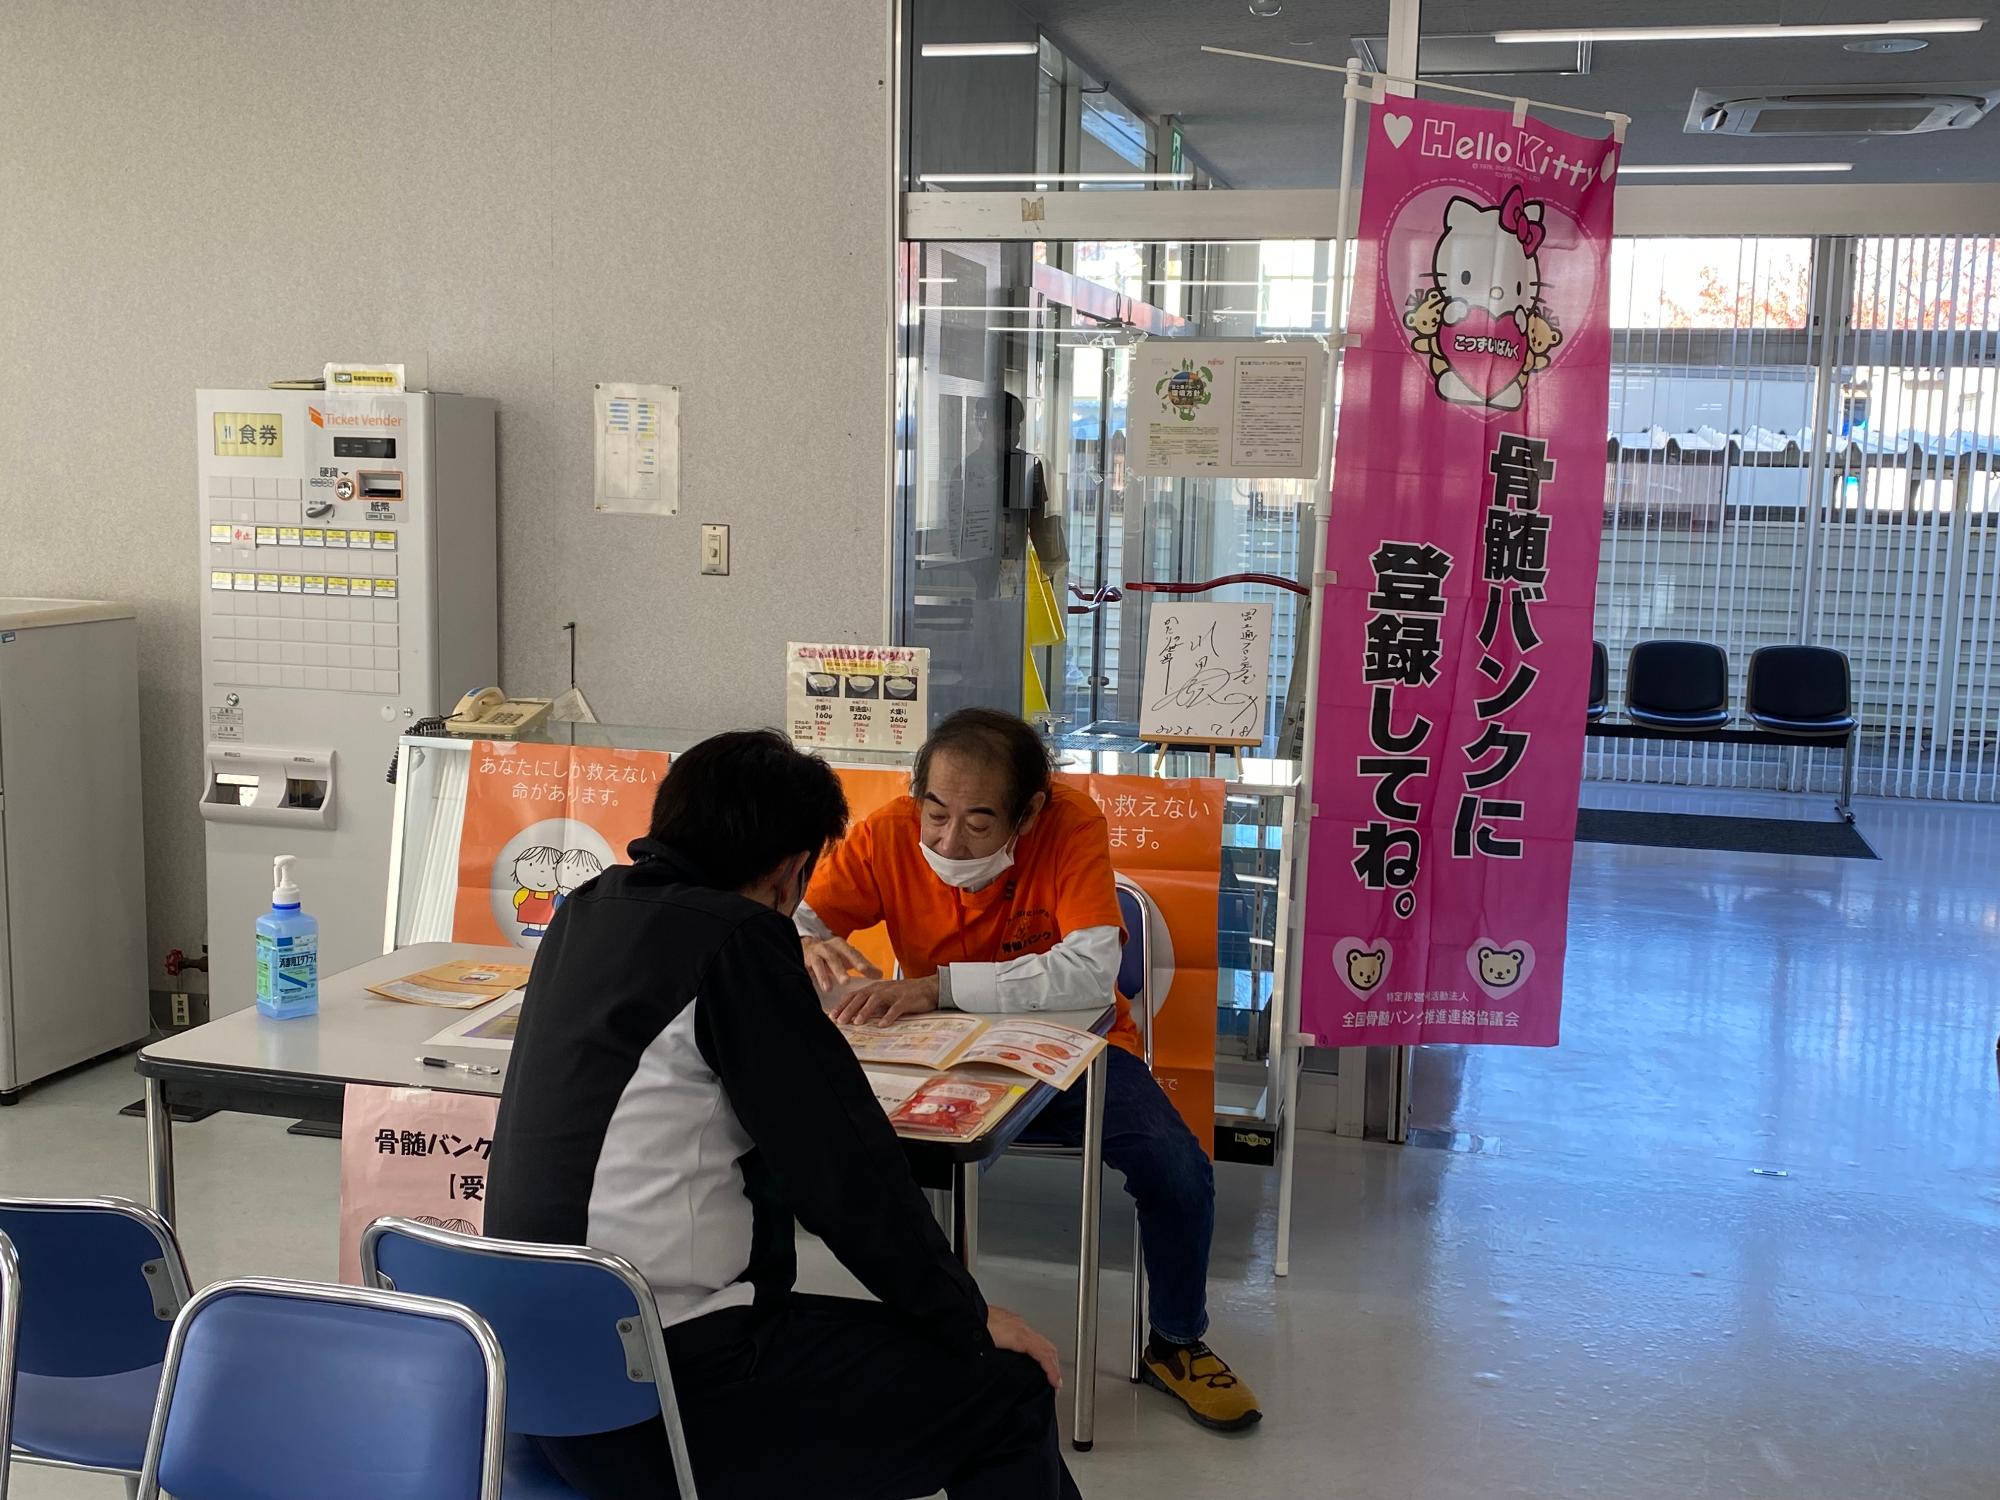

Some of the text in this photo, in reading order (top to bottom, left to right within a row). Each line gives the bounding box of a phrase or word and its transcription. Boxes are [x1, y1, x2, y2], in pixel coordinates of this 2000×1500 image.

[1421, 119, 1599, 192] Hello Kitty
[326, 413, 402, 427] Ticket Vender
[239, 424, 278, 446] 食券
[1452, 431, 1557, 860] 骨髄バンクに
[1351, 540, 1454, 919] 登録してね。
[479, 757, 657, 785] あなたにしか救えない
[511, 782, 620, 807] 命があります。
[1109, 825, 1160, 850] ます。
[375, 1129, 493, 1160] 骨髄バンク
